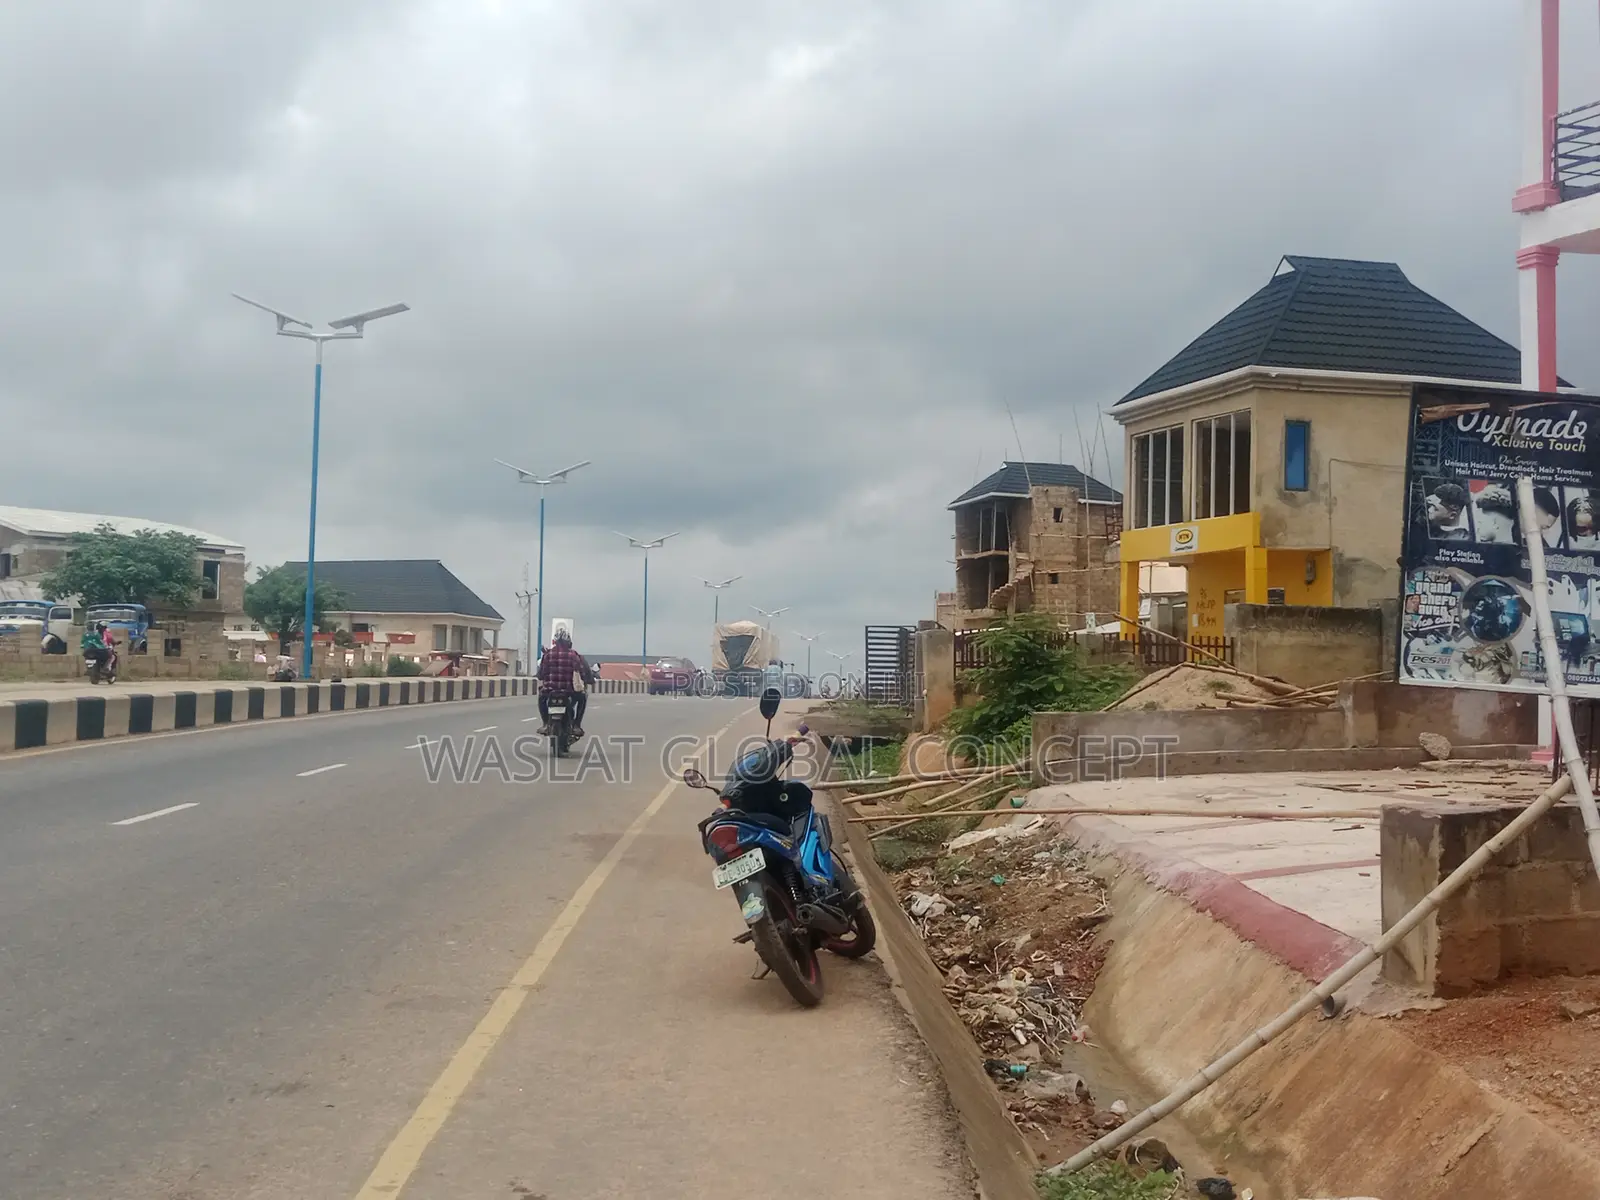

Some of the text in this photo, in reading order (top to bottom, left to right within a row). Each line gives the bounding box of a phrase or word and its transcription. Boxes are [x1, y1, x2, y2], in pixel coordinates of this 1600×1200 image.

[1492, 434, 1587, 453] Xclusive Touch
[1444, 459, 1468, 468] Unisex
[1539, 466, 1555, 474] Hair
[1456, 467, 1471, 475] Hair
[1489, 470, 1508, 480] Jerry
[1434, 554, 1485, 564] also available
[1439, 548, 1481, 559] Play Station
